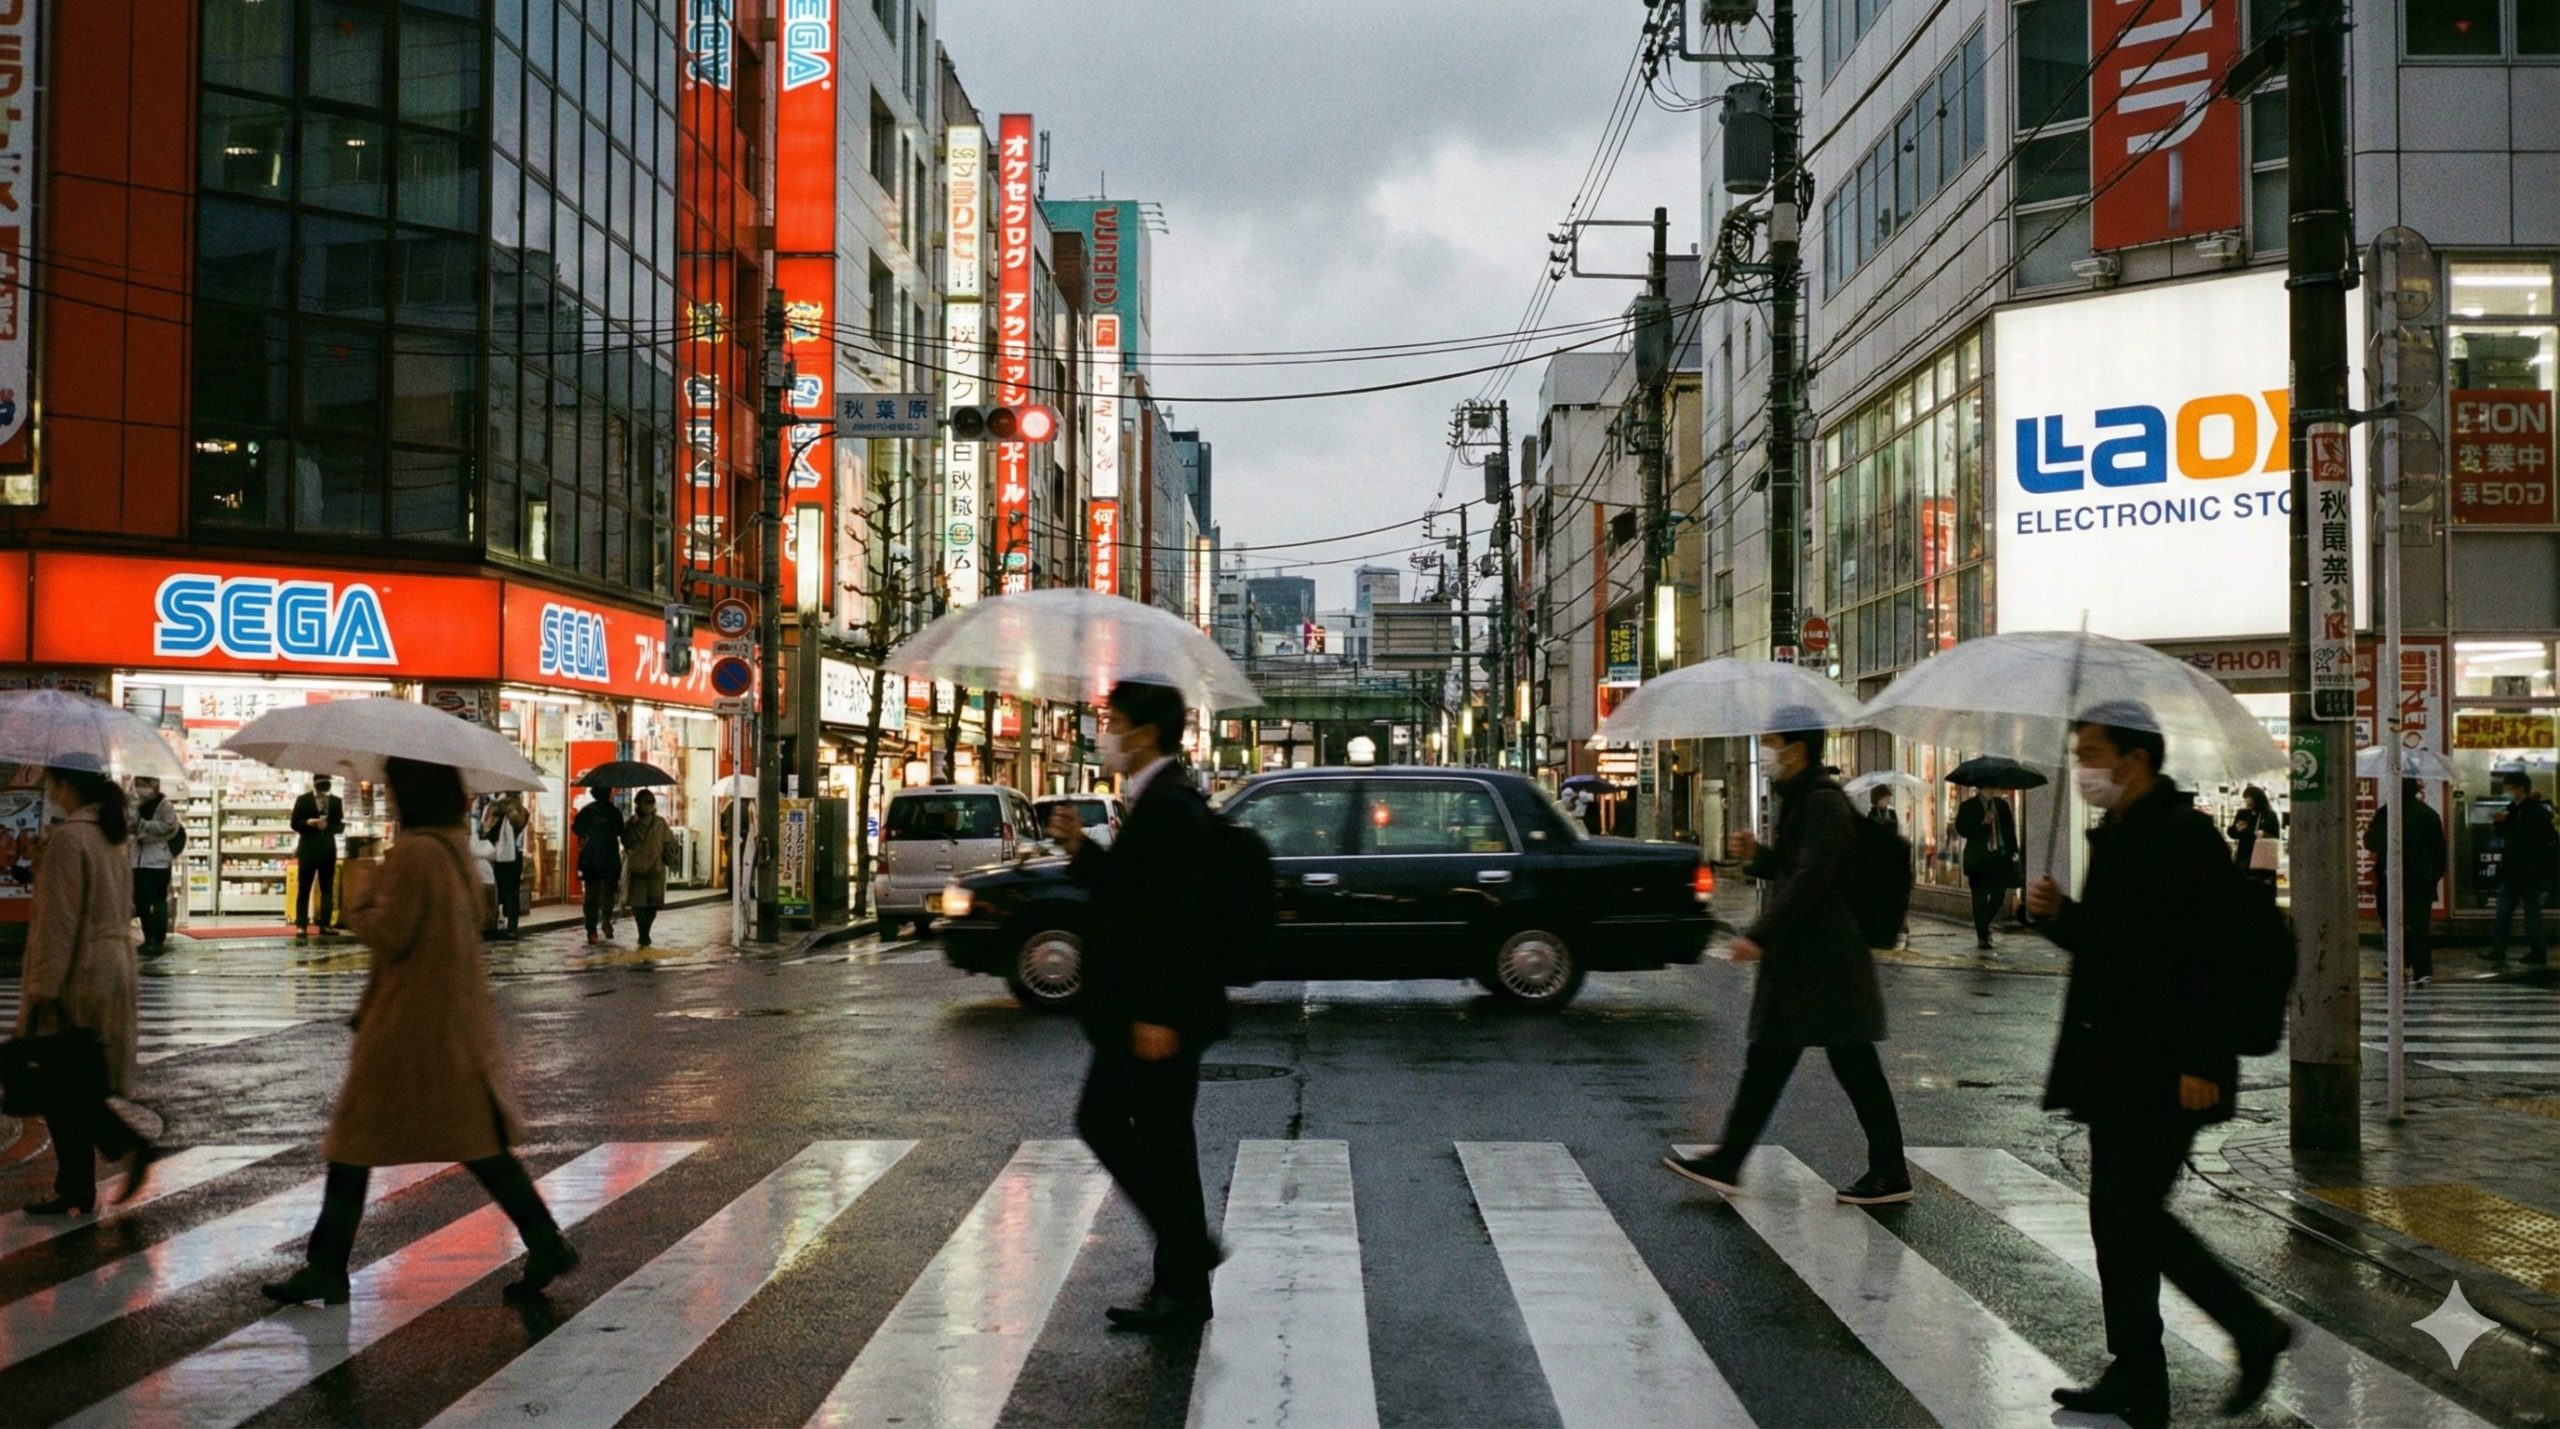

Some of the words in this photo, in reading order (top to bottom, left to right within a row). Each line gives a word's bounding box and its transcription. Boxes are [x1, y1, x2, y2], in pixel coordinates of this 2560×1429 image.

[2017, 496, 2221, 535] ELECTRONIC
[154, 573, 399, 665] SEGA
[540, 602, 610, 684] SEGA
